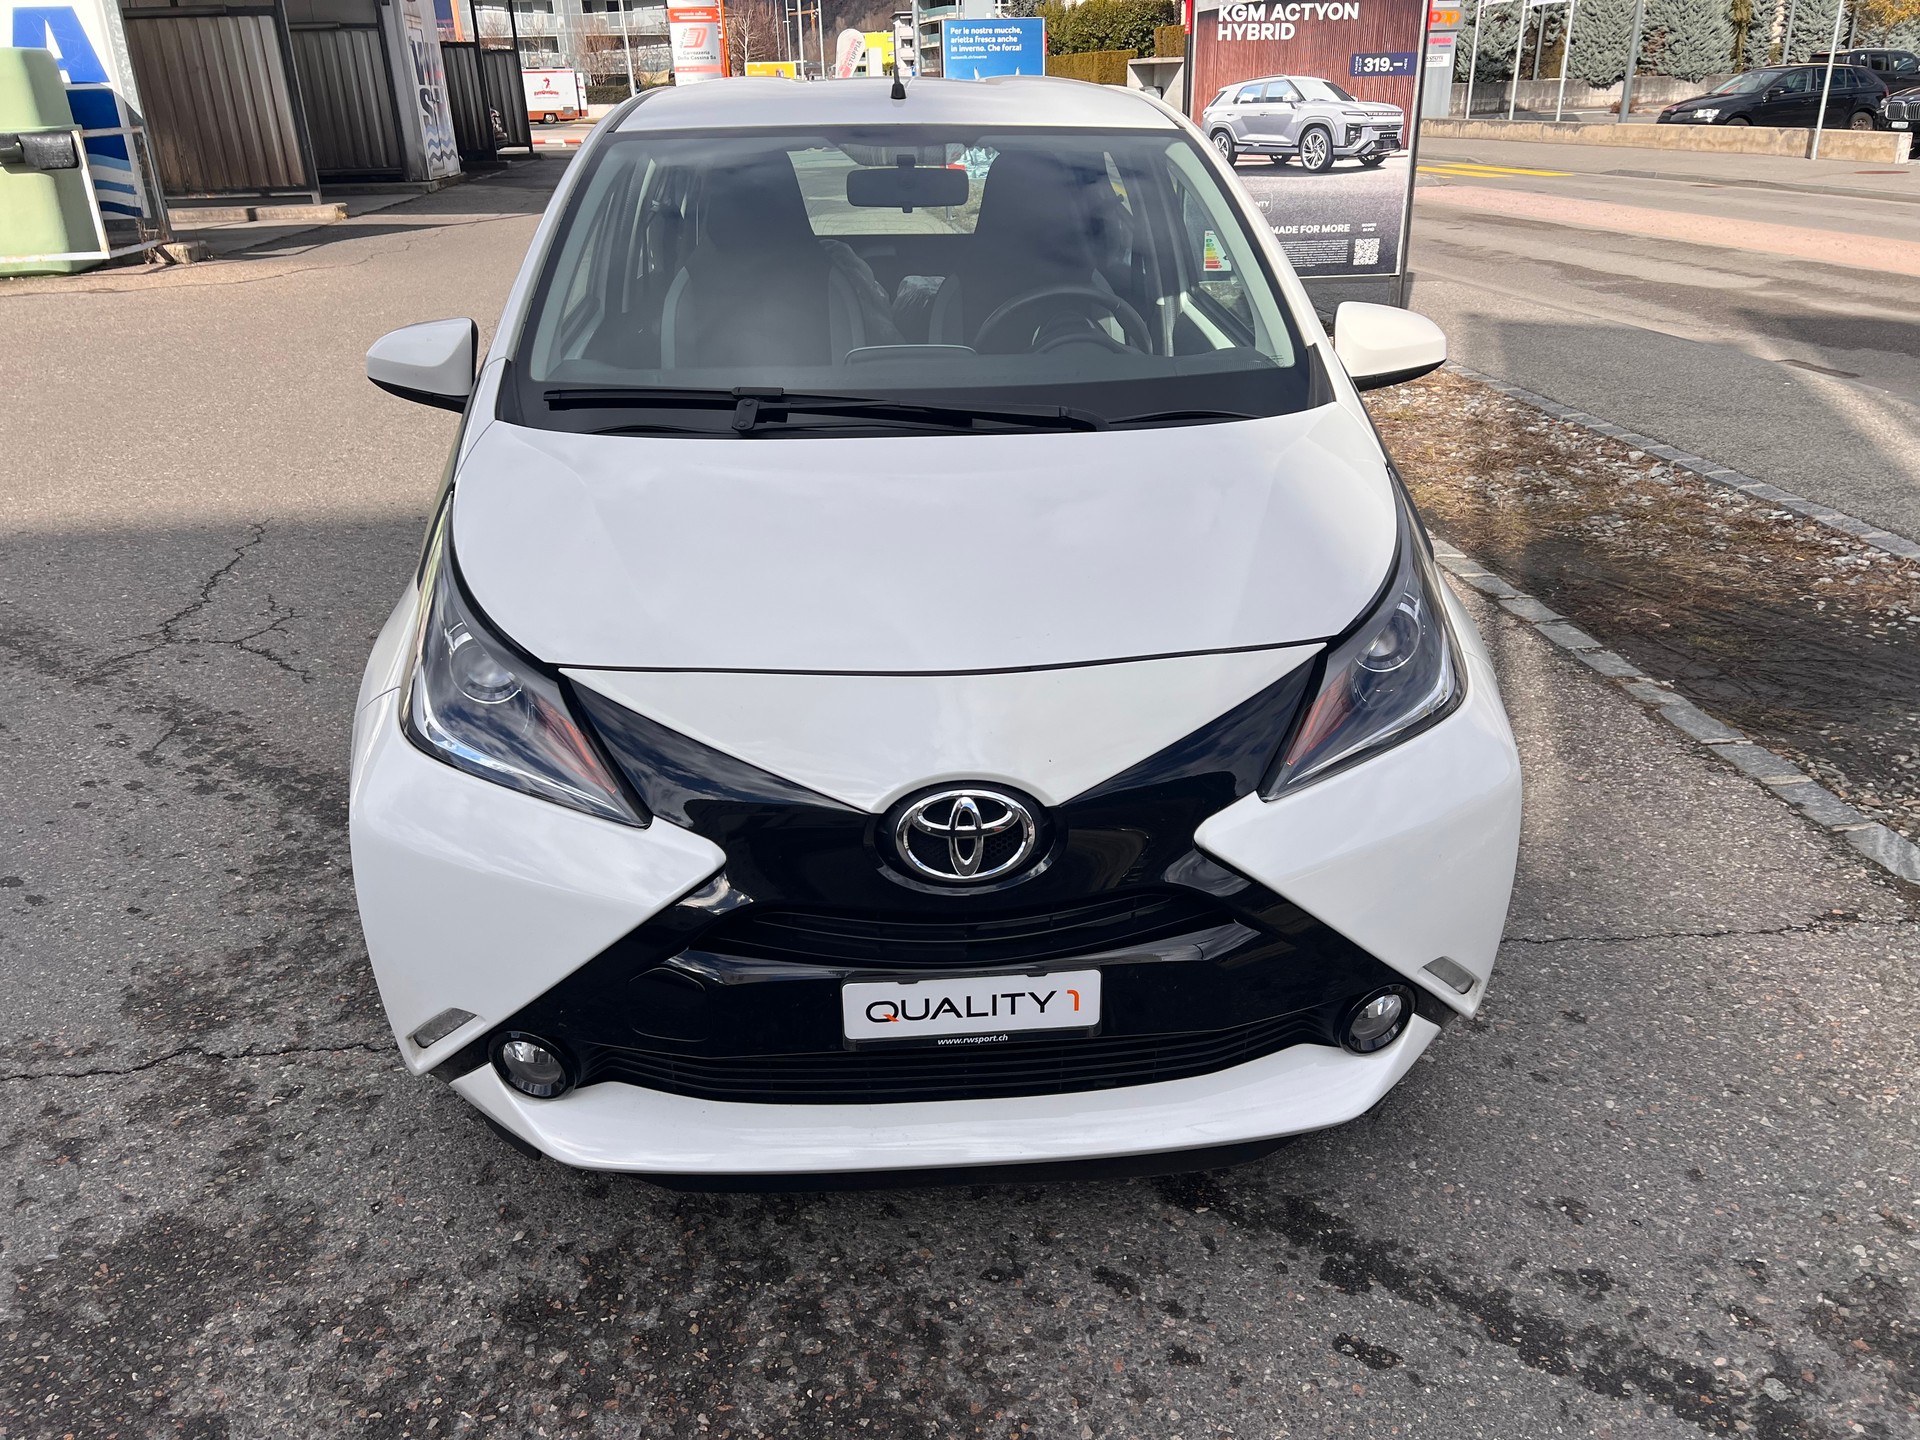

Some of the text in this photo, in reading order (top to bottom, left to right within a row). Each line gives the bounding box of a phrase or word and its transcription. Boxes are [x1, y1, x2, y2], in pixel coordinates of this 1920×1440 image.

[1218, 2, 1359, 22] KGM ACTYON
[950, 27, 961, 35] Per
[971, 27, 993, 35] nostre
[994, 26, 1022, 35] mucche,
[1217, 23, 1296, 41] HYBRID
[950, 36, 974, 44] arietta
[975, 35, 996, 43] fresca
[848, 41, 862, 67] STUPPIA
[951, 44, 958, 52] in
[959, 44, 986, 52] inverno.
[987, 44, 1001, 52] Che
[1271, 224, 1351, 234] MADE FOR MORE
[866, 990, 1080, 1023] QUALITY 1
[937, 1034, 1009, 1046] www.rwsport.ch
